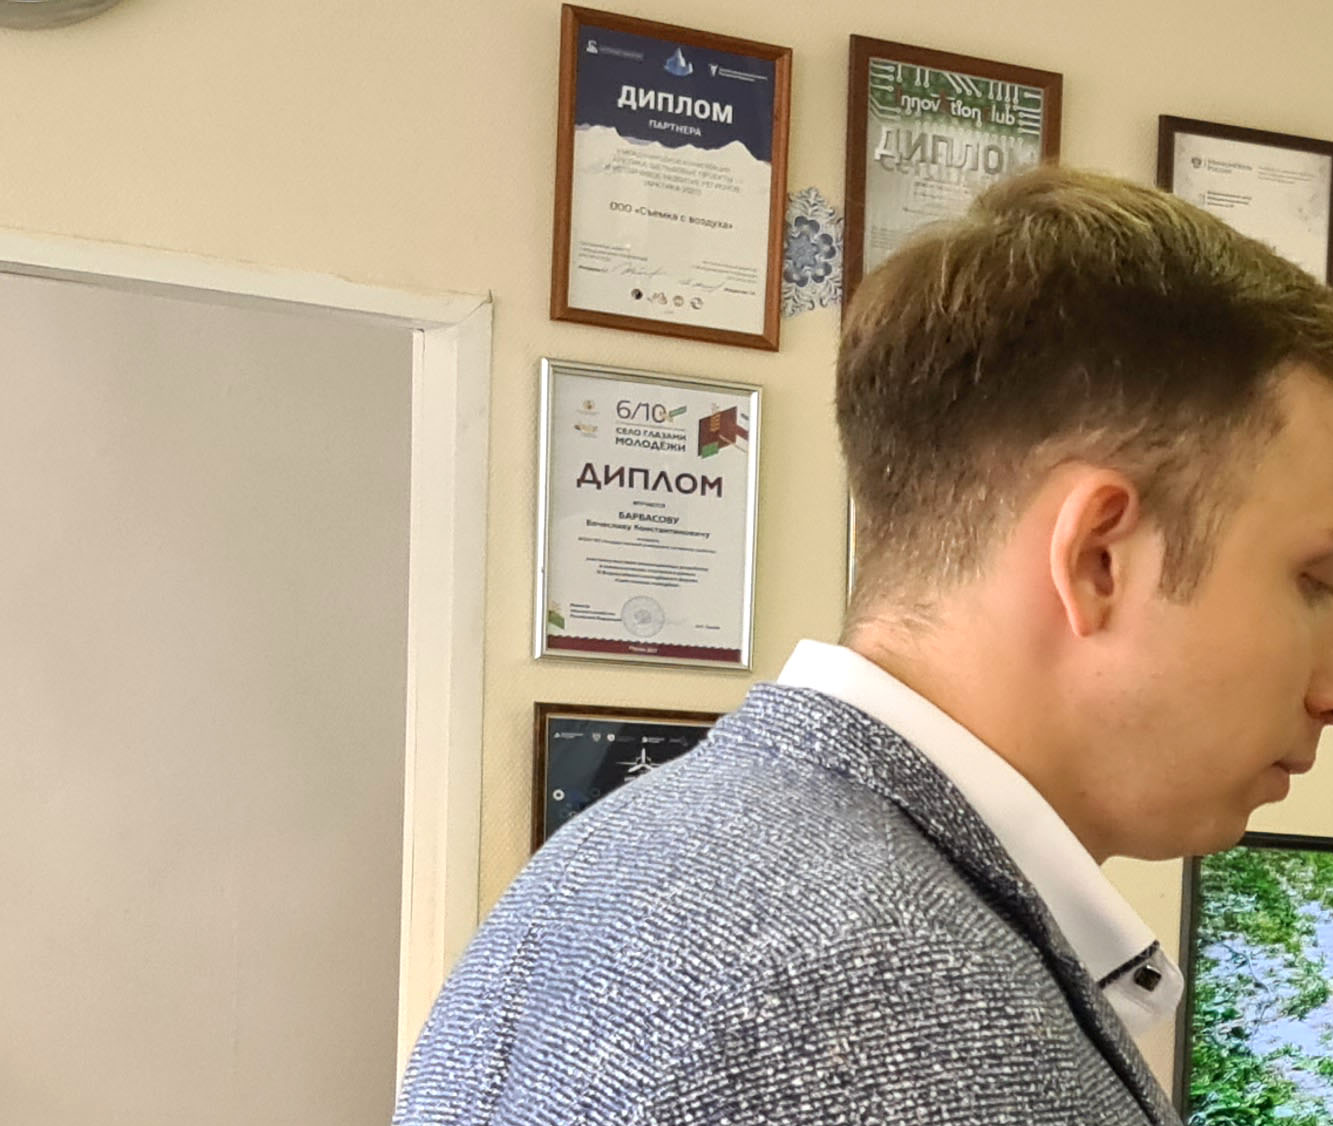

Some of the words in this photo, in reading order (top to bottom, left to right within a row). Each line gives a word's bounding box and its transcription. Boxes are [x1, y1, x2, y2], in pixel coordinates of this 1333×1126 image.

[617, 84, 733, 124] ДИПЛОМ
[647, 118, 702, 137] ПАРТНЕРА
[610, 201, 632, 213] ООО
[616, 400, 666, 423] 6/10
[615, 427, 642, 437] СЕЛО
[642, 430, 687, 441] ГЛАЗАМИ
[576, 462, 723, 498] ДИПЛОМ
